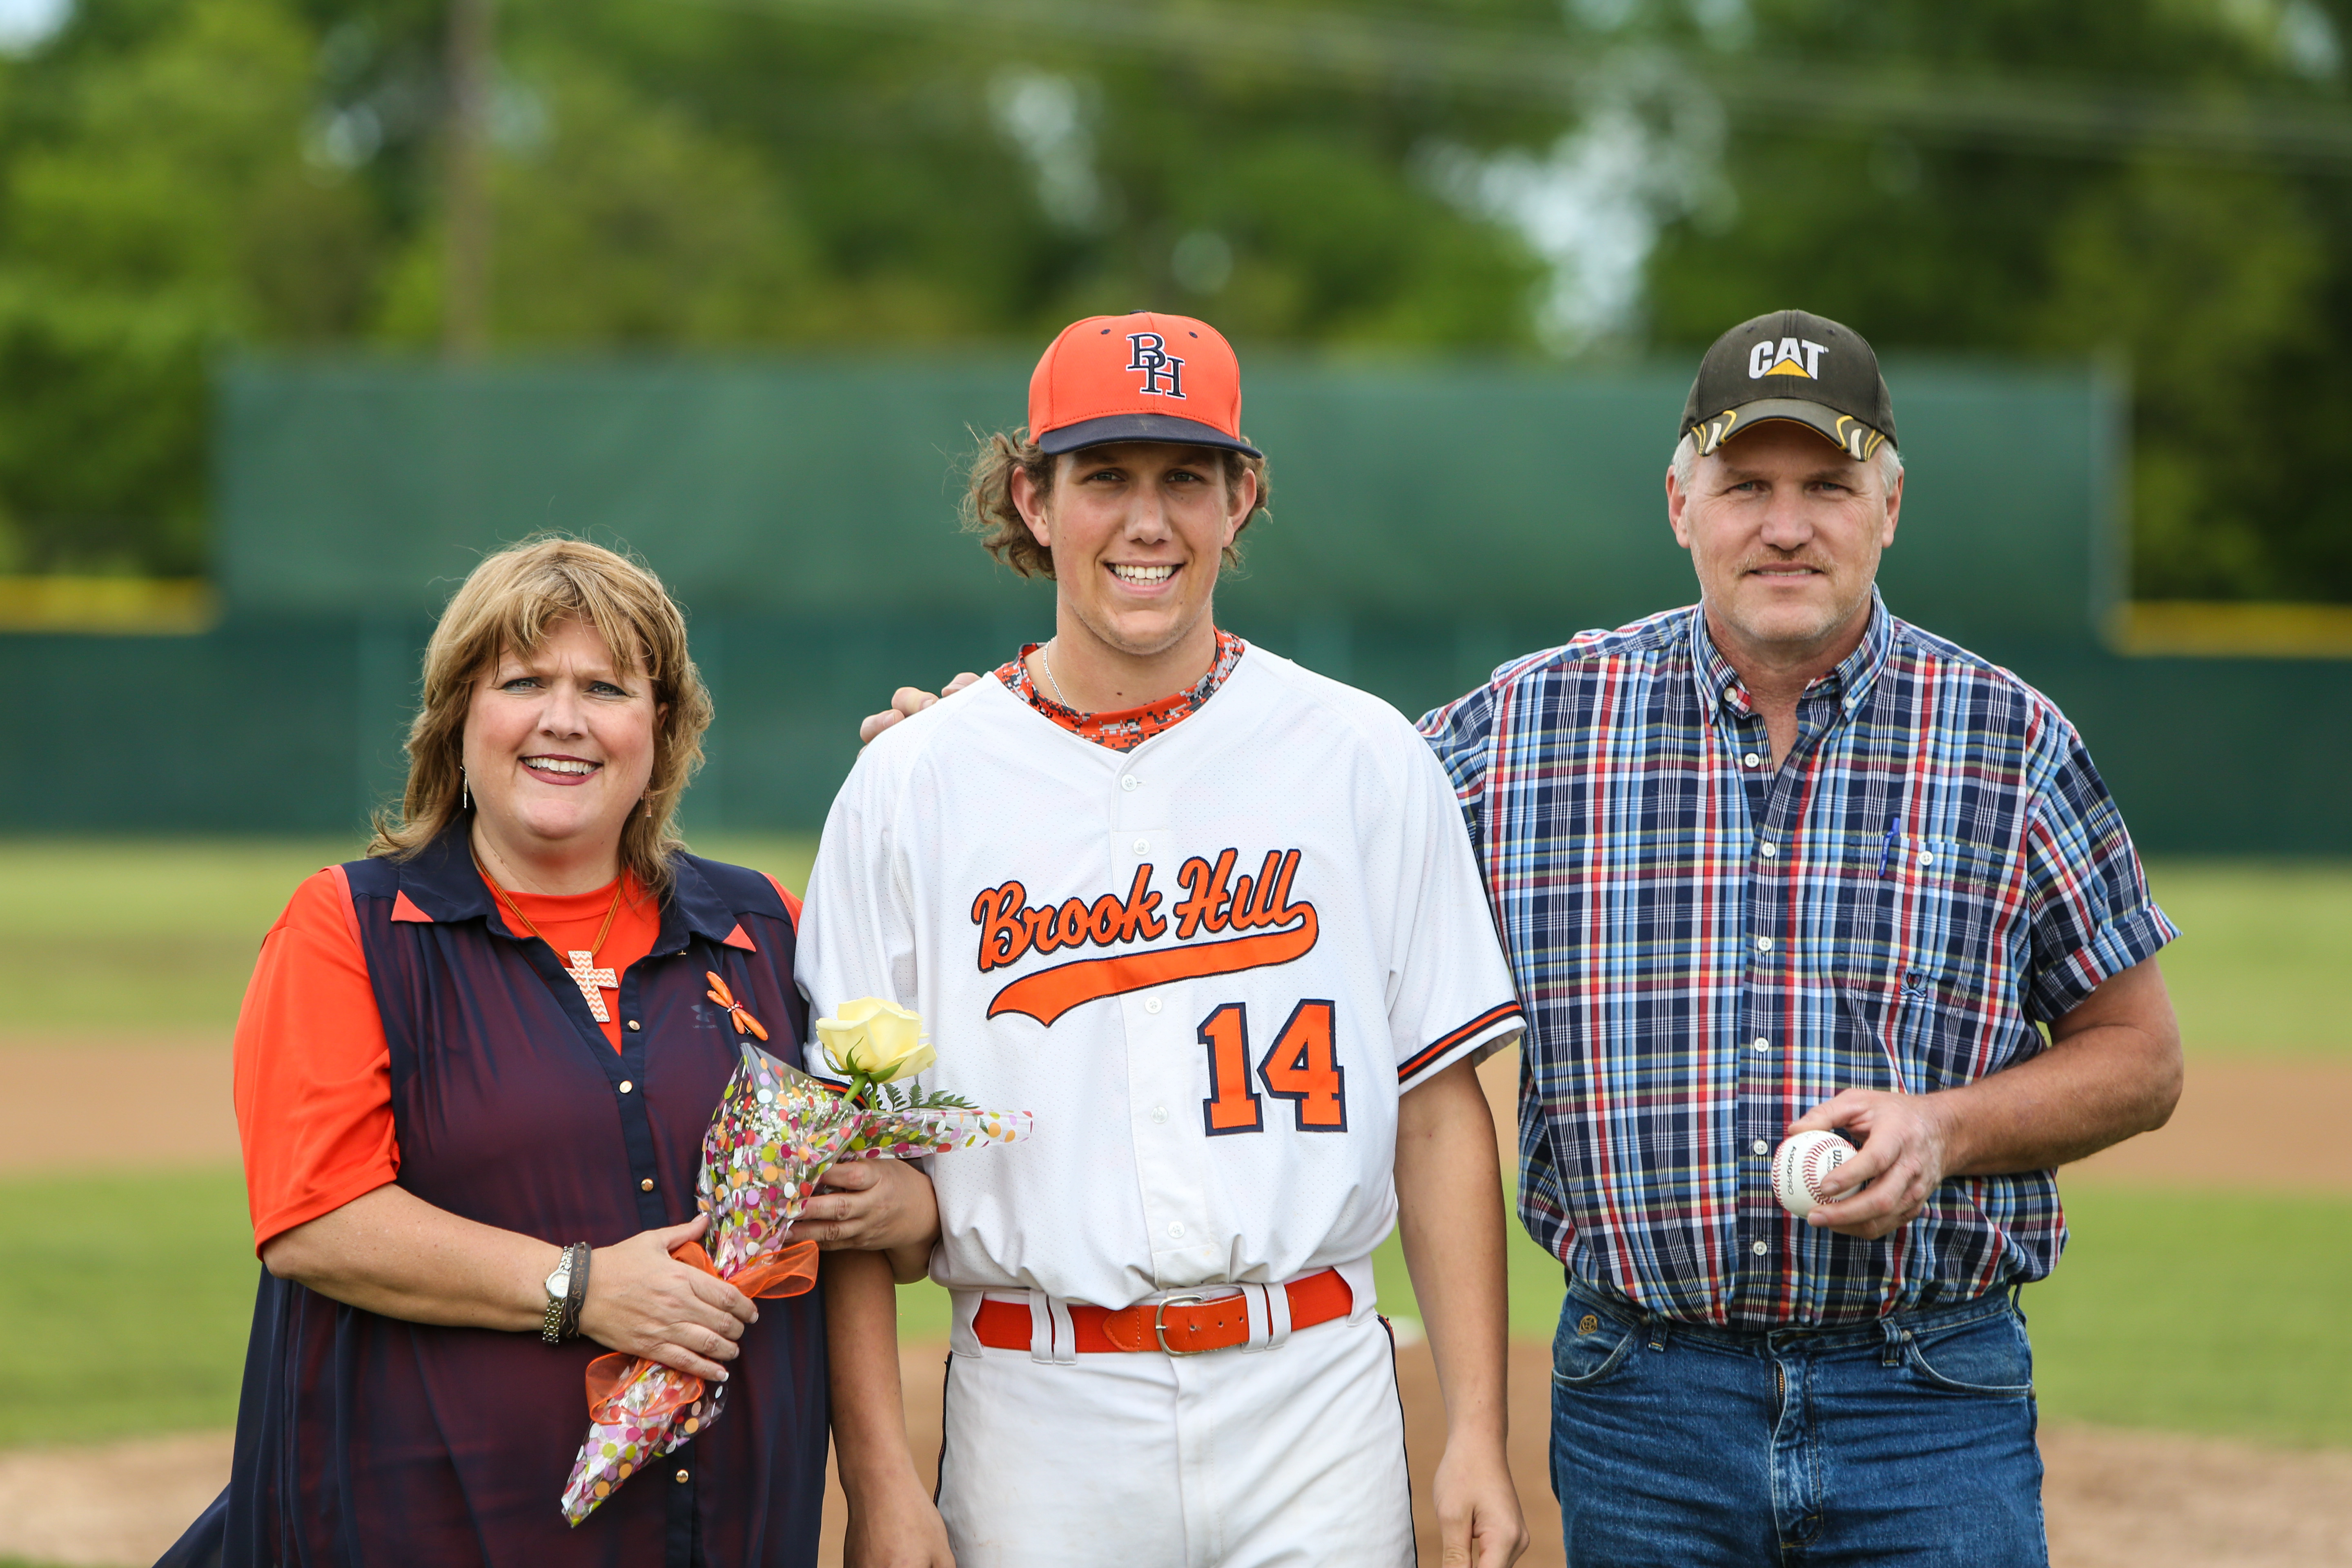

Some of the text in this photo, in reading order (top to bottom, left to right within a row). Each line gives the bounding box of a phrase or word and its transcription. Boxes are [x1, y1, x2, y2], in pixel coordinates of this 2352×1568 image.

[1748, 337, 1825, 380] CAT
[971, 847, 1303, 973] Brook Hill
[1196, 999, 1348, 1137] 14
[1787, 1146, 1796, 1195] A1010PRO
